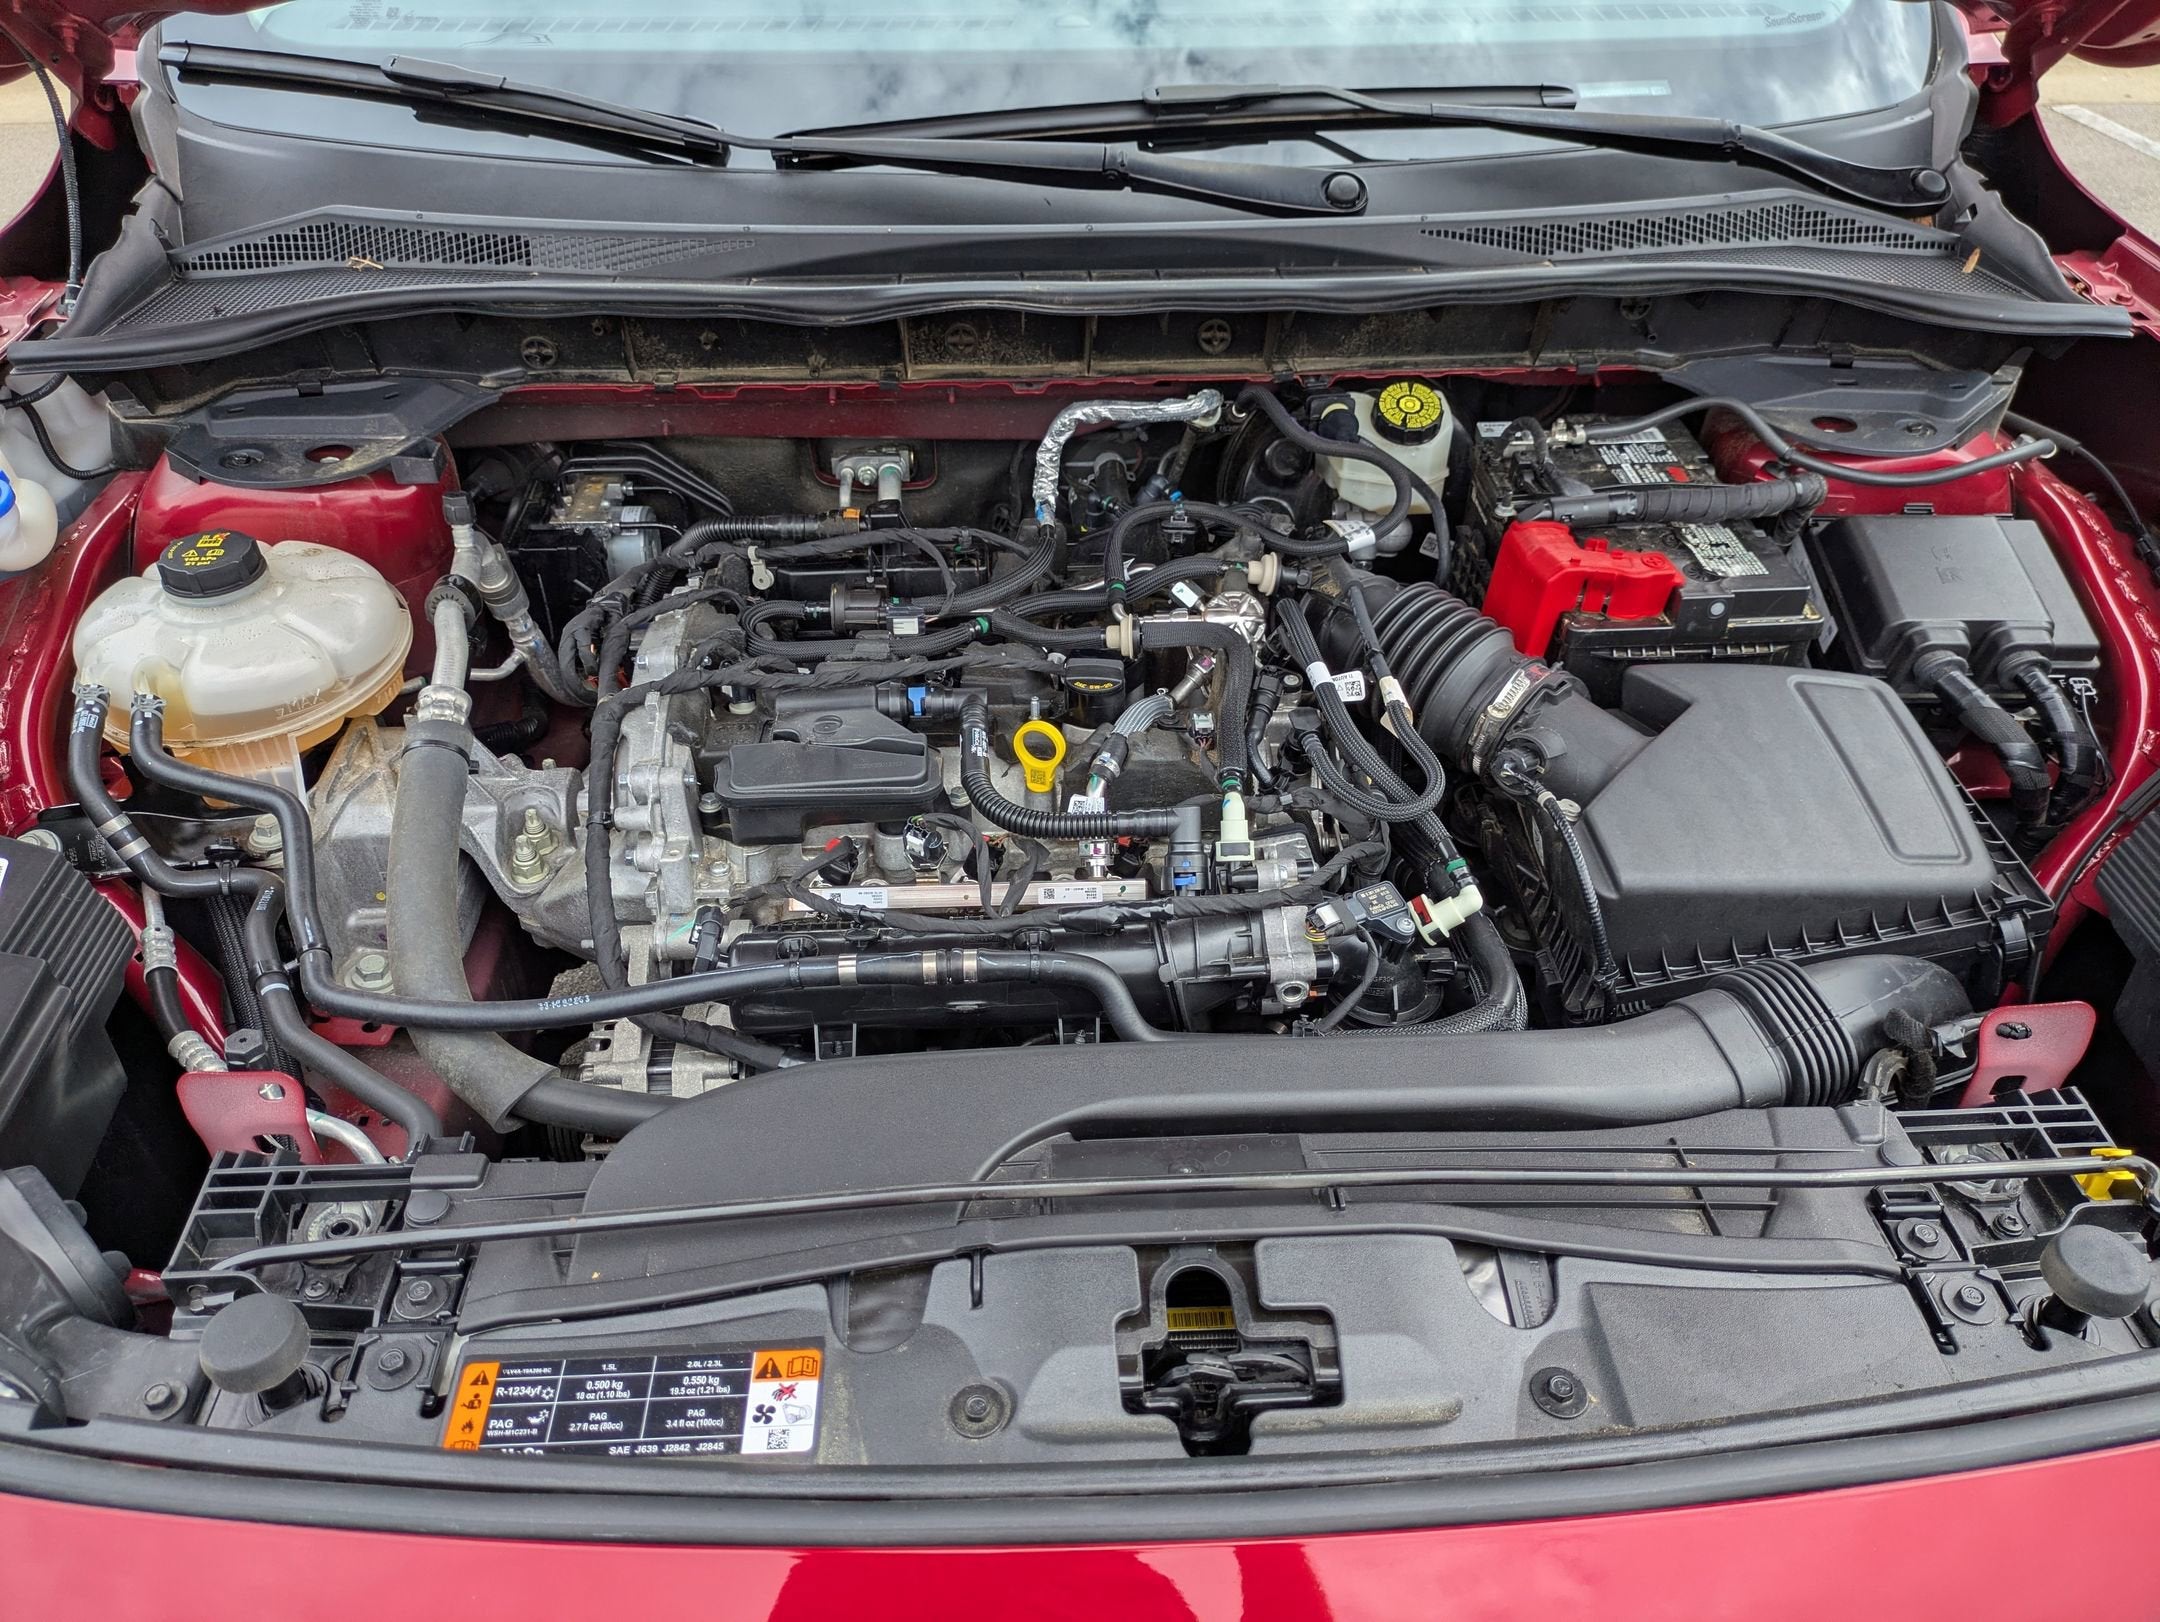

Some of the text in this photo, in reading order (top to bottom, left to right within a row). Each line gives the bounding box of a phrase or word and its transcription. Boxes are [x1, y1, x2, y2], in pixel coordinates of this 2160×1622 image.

[586, 1379, 624, 1391] 0.500 kg
[683, 1375, 720, 1386] 0.550 kg
[496, 1385, 542, 1397] R-1234yf
[585, 1392, 596, 1400] oz
[596, 1390, 615, 1400] (1.10
[616, 1389, 631, 1399] lbs)
[670, 1385, 731, 1396] 19.5 oz (1.21 lbs)
[589, 1412, 608, 1421] PAG
[687, 1409, 706, 1418] PAG
[488, 1420, 514, 1429] PAG
[568, 1422, 582, 1432] 2.7
[589, 1422, 599, 1430] oz
[665, 1419, 678, 1429] 3.4
[685, 1419, 696, 1427] oz
[609, 1442, 724, 1455] SAE J639 J2842 J2845
